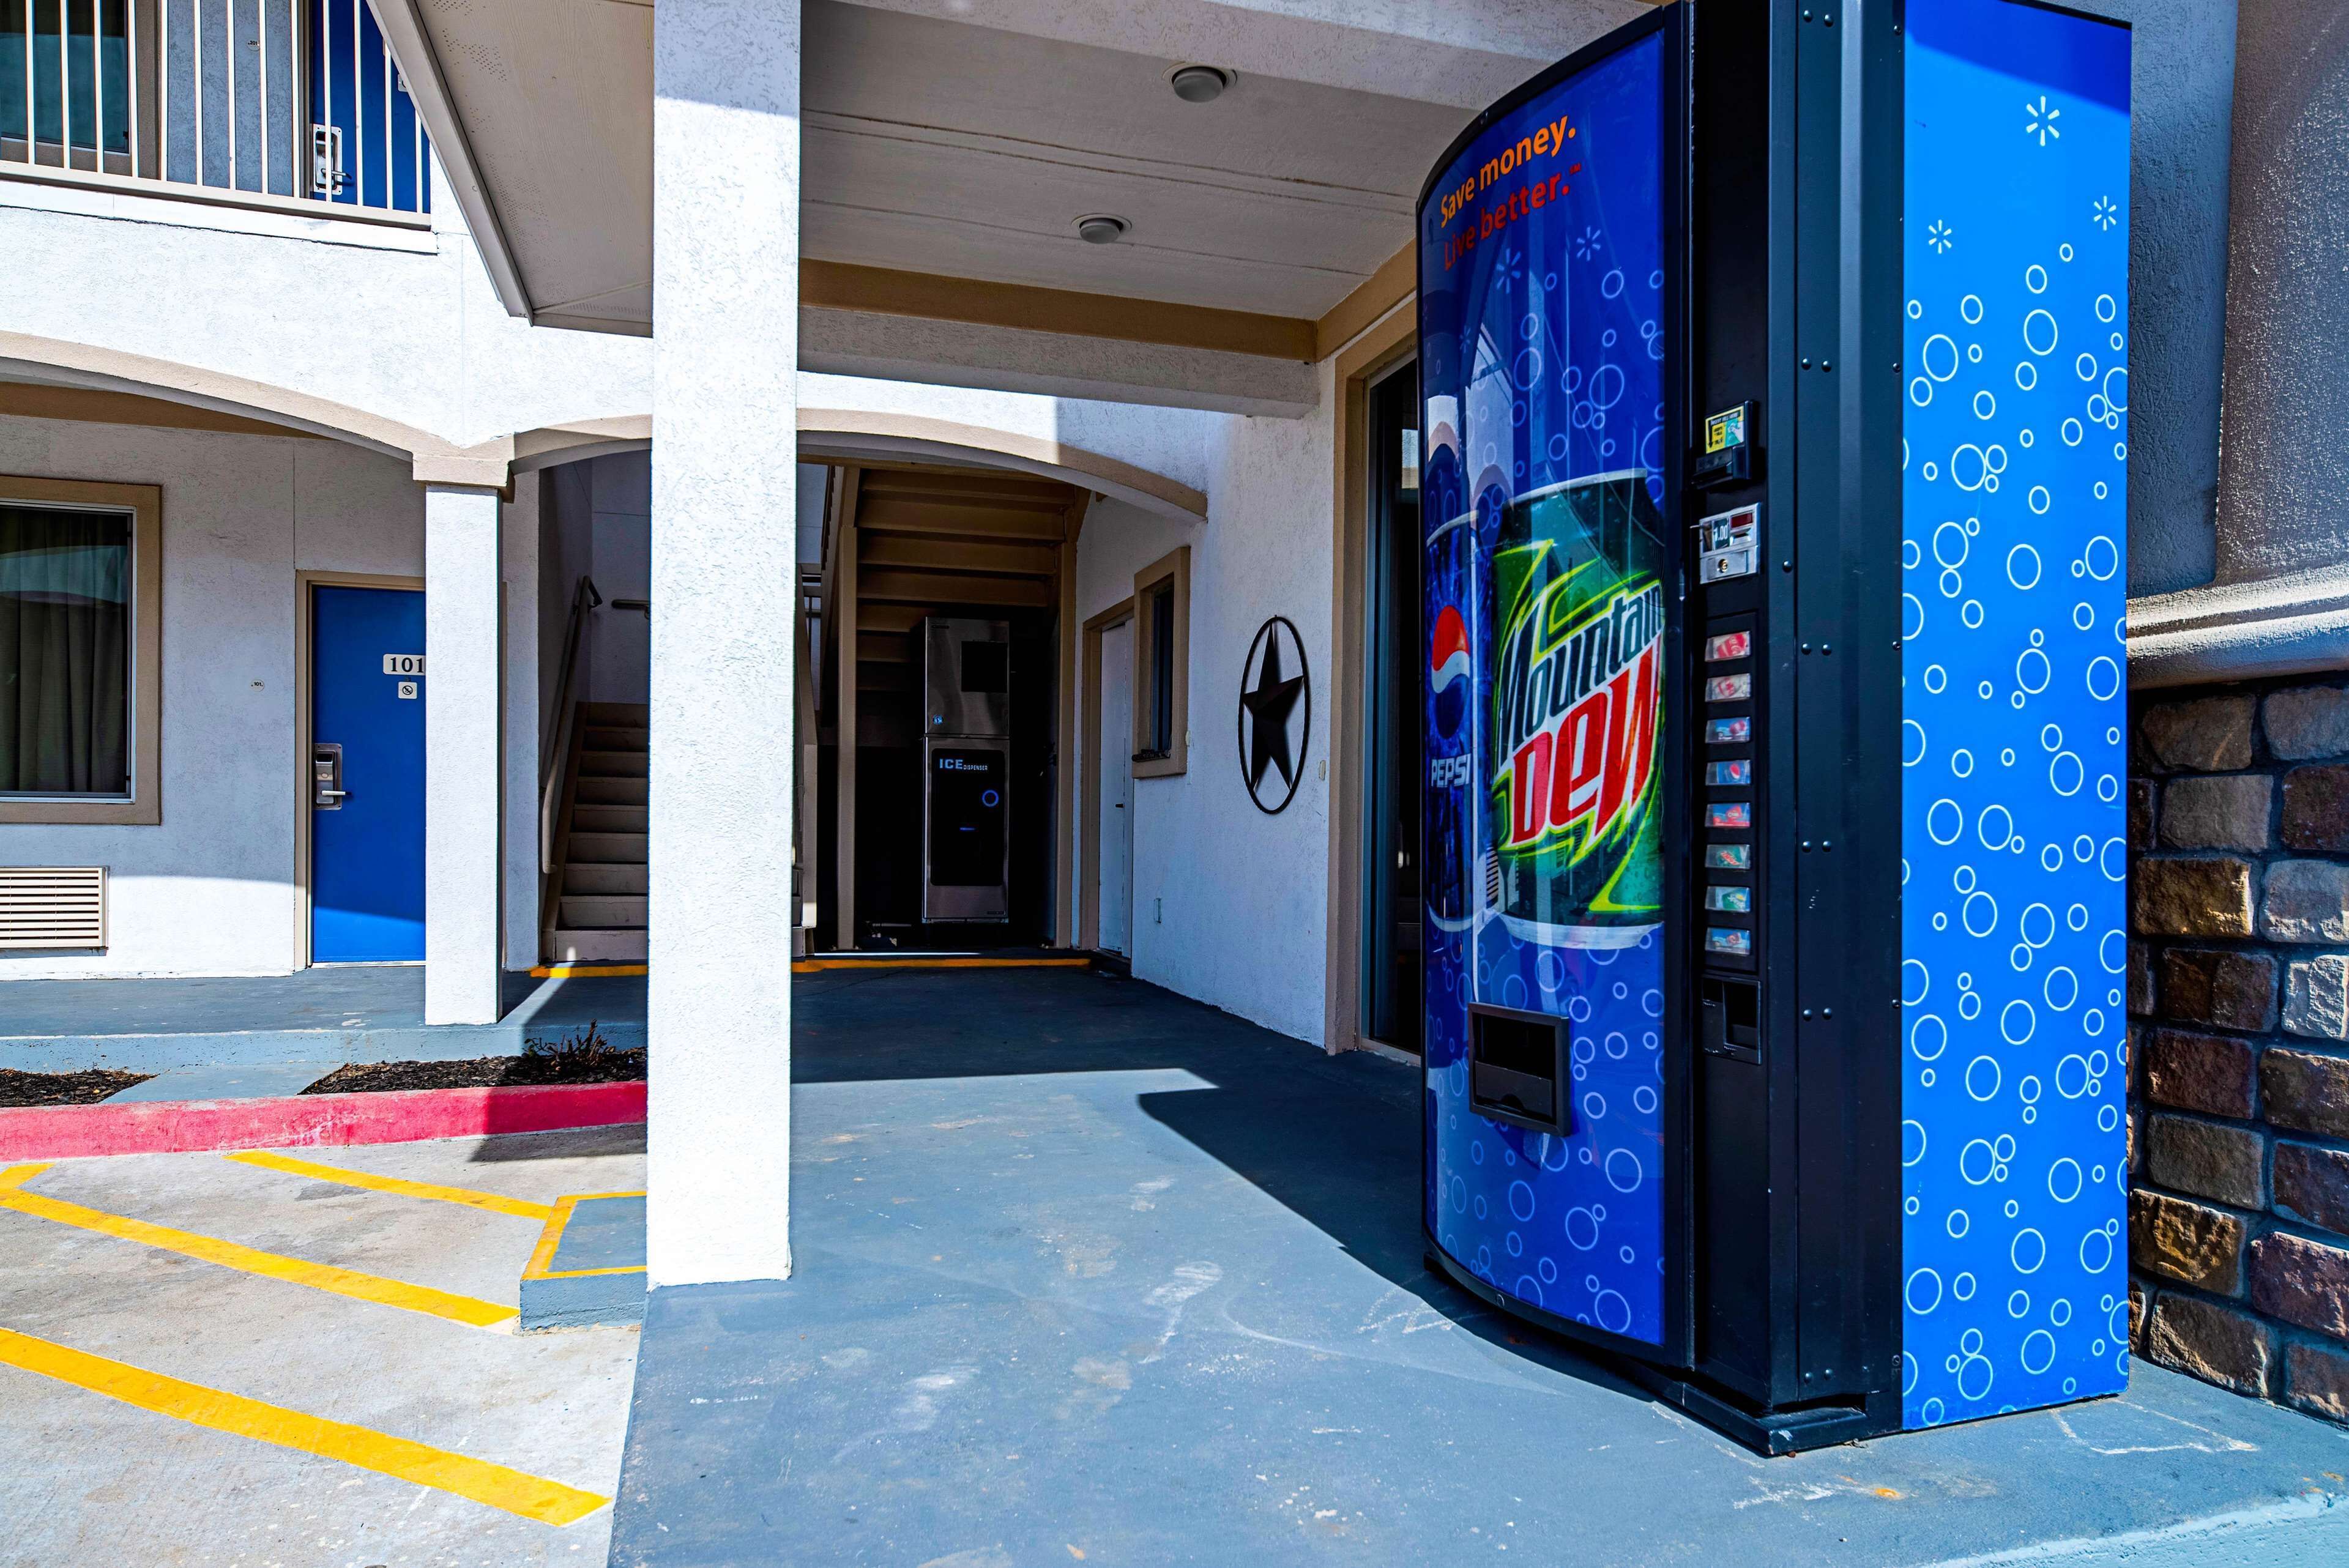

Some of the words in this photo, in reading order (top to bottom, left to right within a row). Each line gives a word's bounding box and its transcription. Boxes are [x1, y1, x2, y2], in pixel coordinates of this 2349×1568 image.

[1440, 177, 1475, 228] Save
[1480, 116, 1576, 191] money.
[1443, 225, 1476, 271] Live
[1480, 173, 1569, 240] better.
[390, 656, 424, 673] 101
[1498, 586, 1662, 767] Mountain
[939, 759, 963, 769] ICE
[1431, 753, 1471, 787] PEPSI
